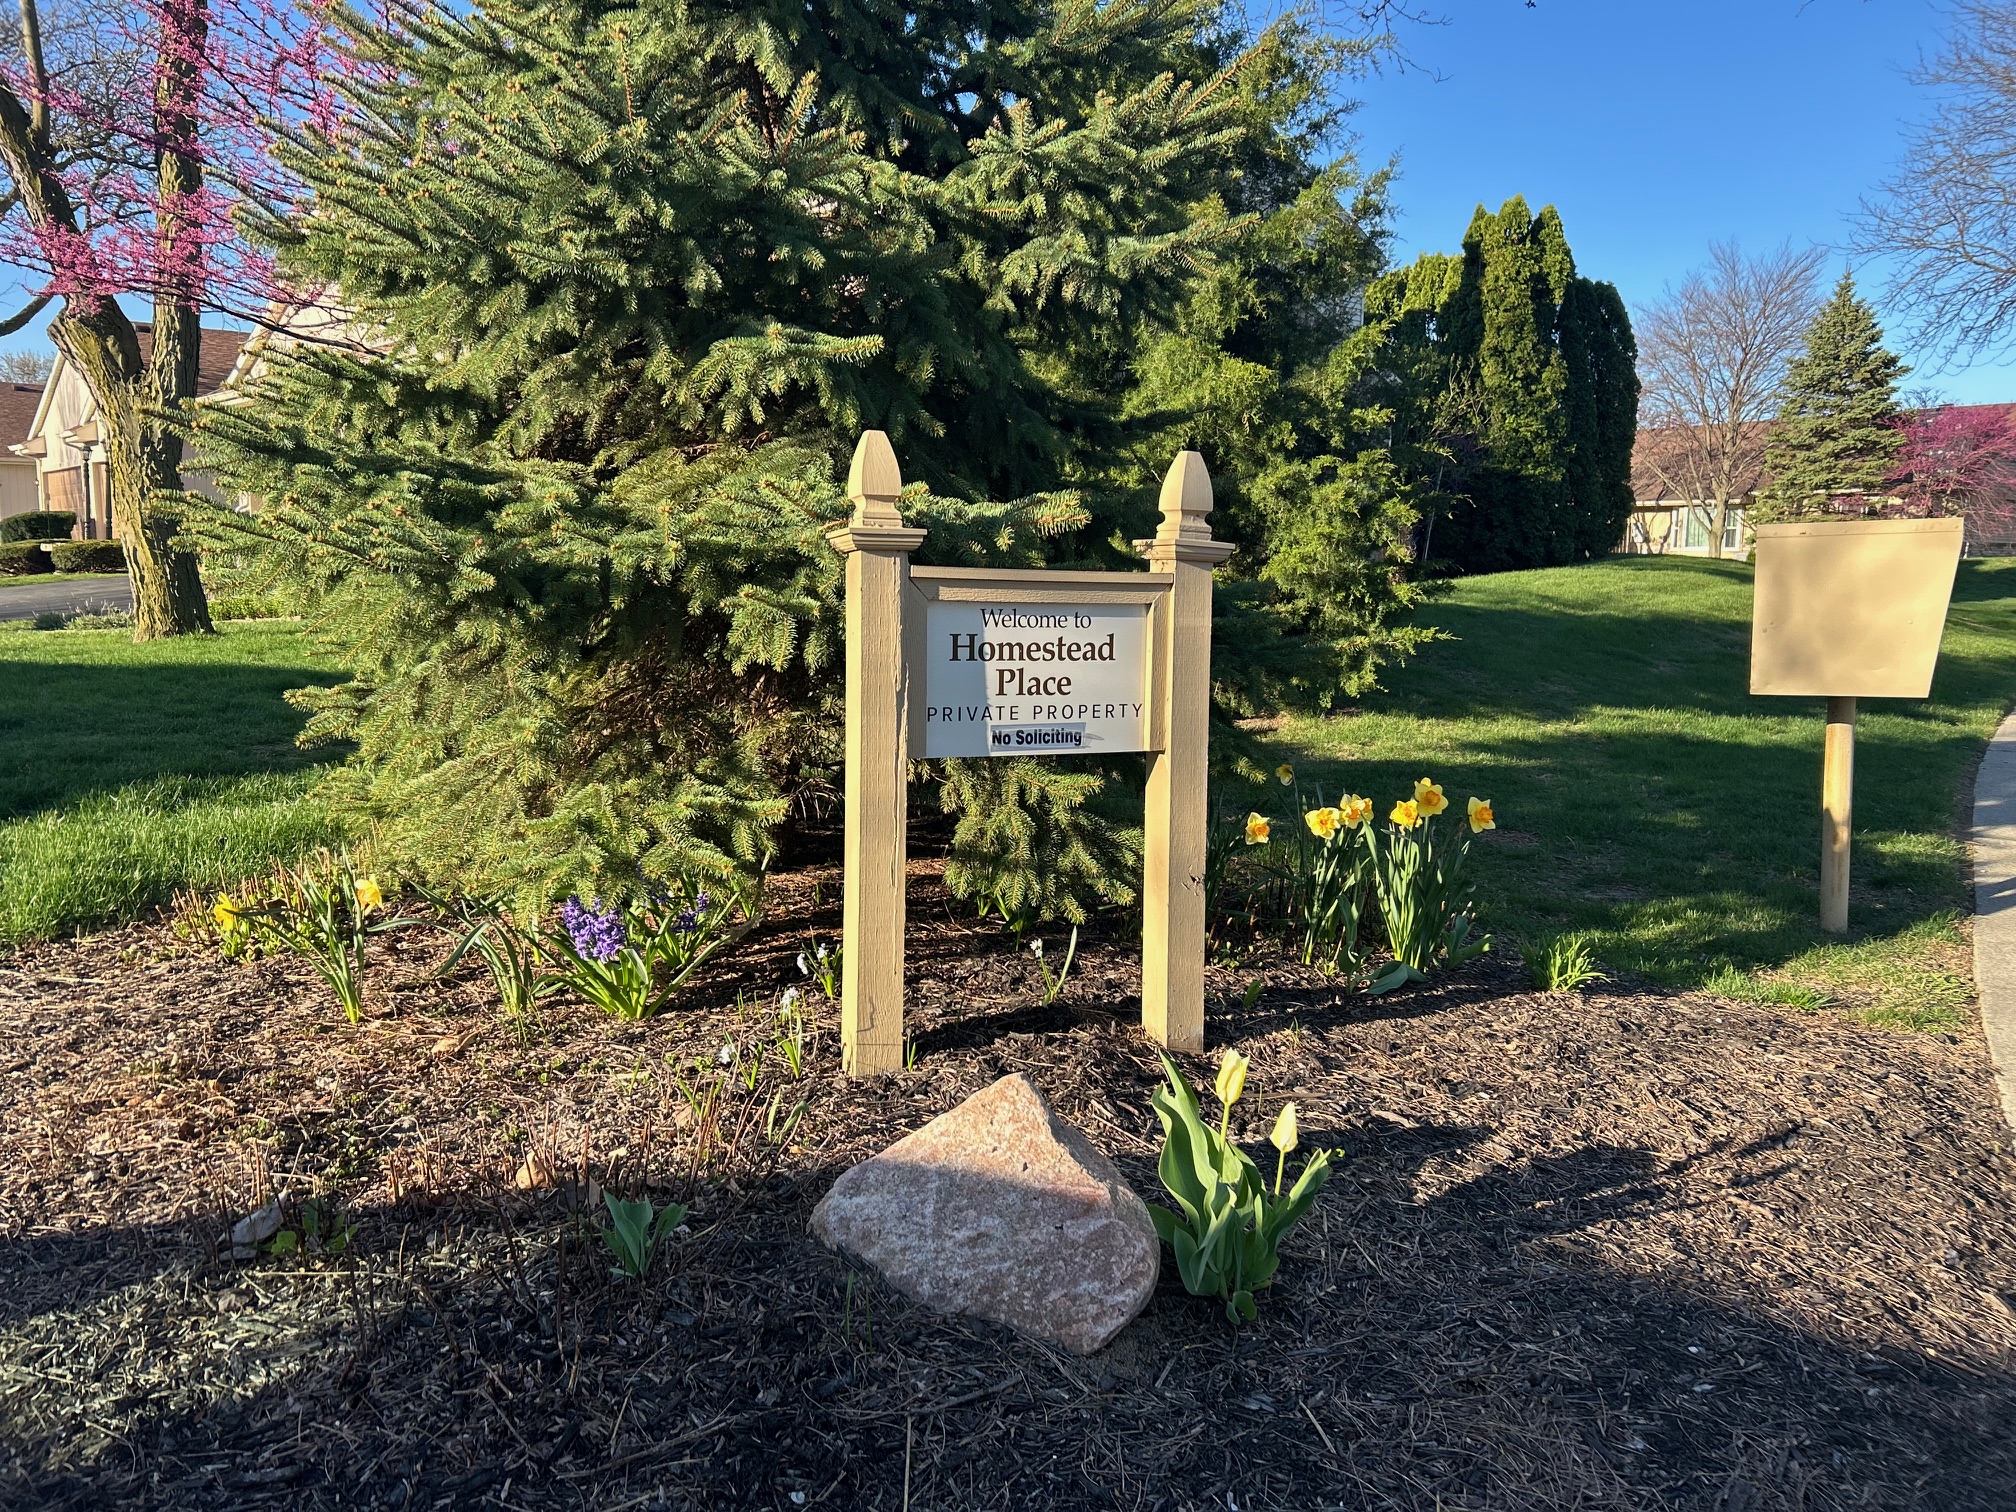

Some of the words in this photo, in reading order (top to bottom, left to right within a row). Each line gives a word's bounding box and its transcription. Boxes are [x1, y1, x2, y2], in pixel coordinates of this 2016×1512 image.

[980, 608, 1068, 628] Welcome
[1074, 612, 1092, 628] to
[949, 633, 1116, 662] Homestead
[995, 667, 1072, 697] Place
[927, 705, 1019, 722] PRIVATE
[1033, 703, 1143, 720] PROPERTY
[992, 730, 1011, 746] No
[1015, 727, 1082, 746] Soliciting
